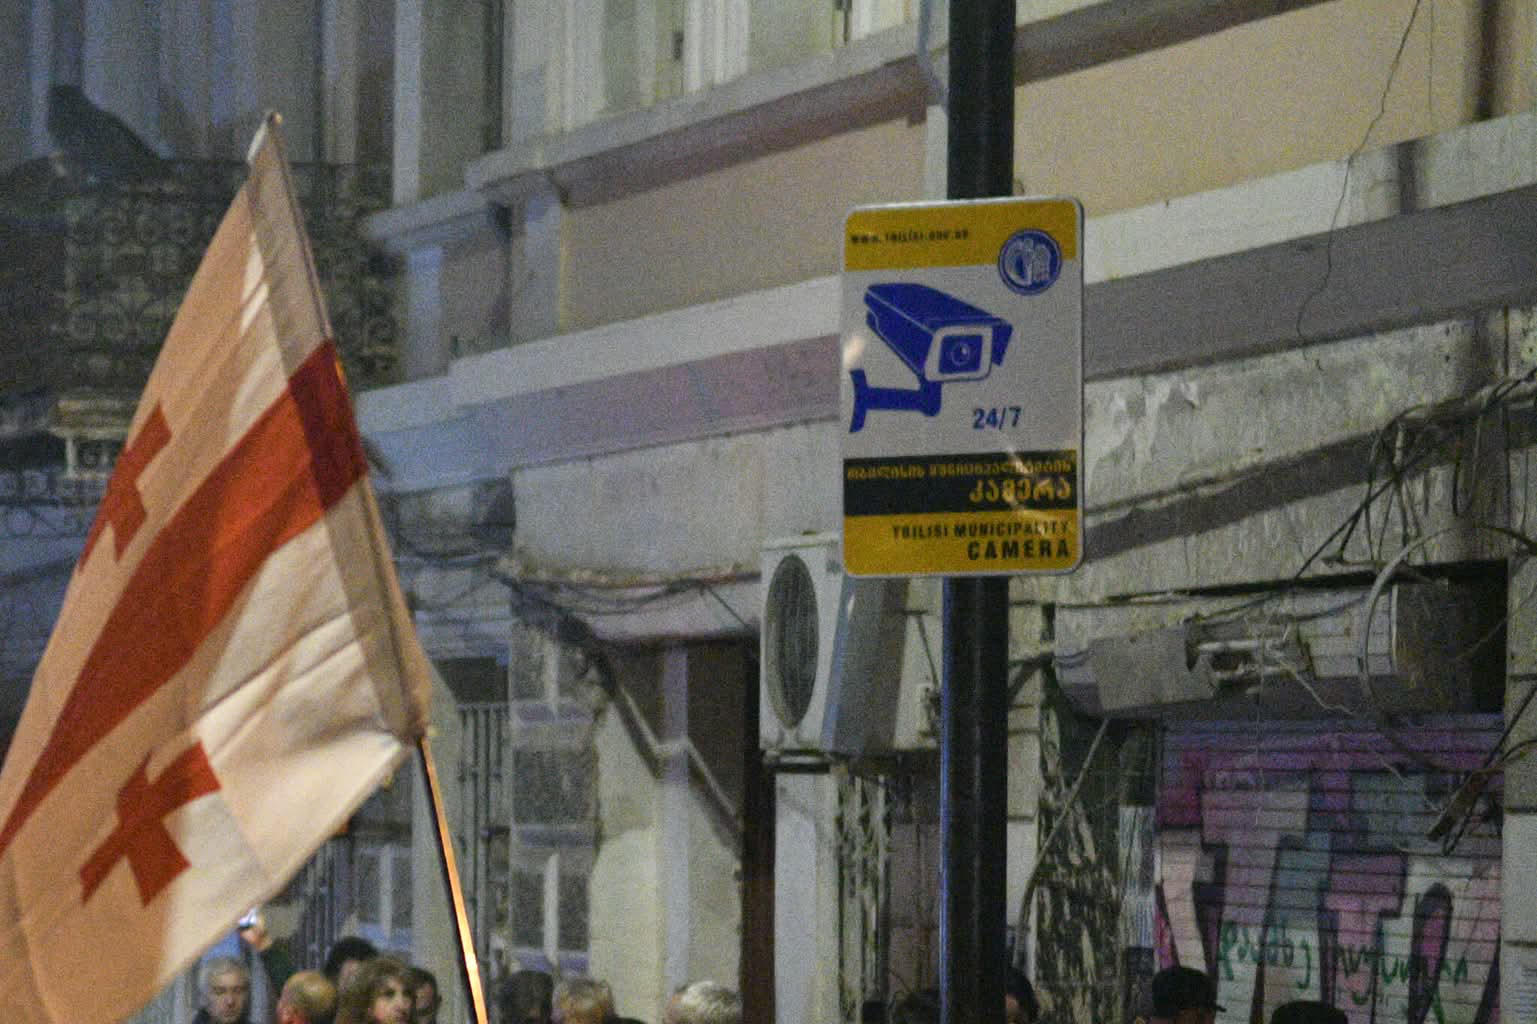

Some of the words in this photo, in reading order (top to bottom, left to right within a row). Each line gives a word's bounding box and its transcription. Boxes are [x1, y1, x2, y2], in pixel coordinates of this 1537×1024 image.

[972, 407, 1023, 431] 24/7
[969, 477, 1072, 503] კამერა
[892, 524, 948, 540] TBILISI
[954, 519, 1070, 538] MUNICIPALITY
[967, 539, 1071, 561] CAMERA
